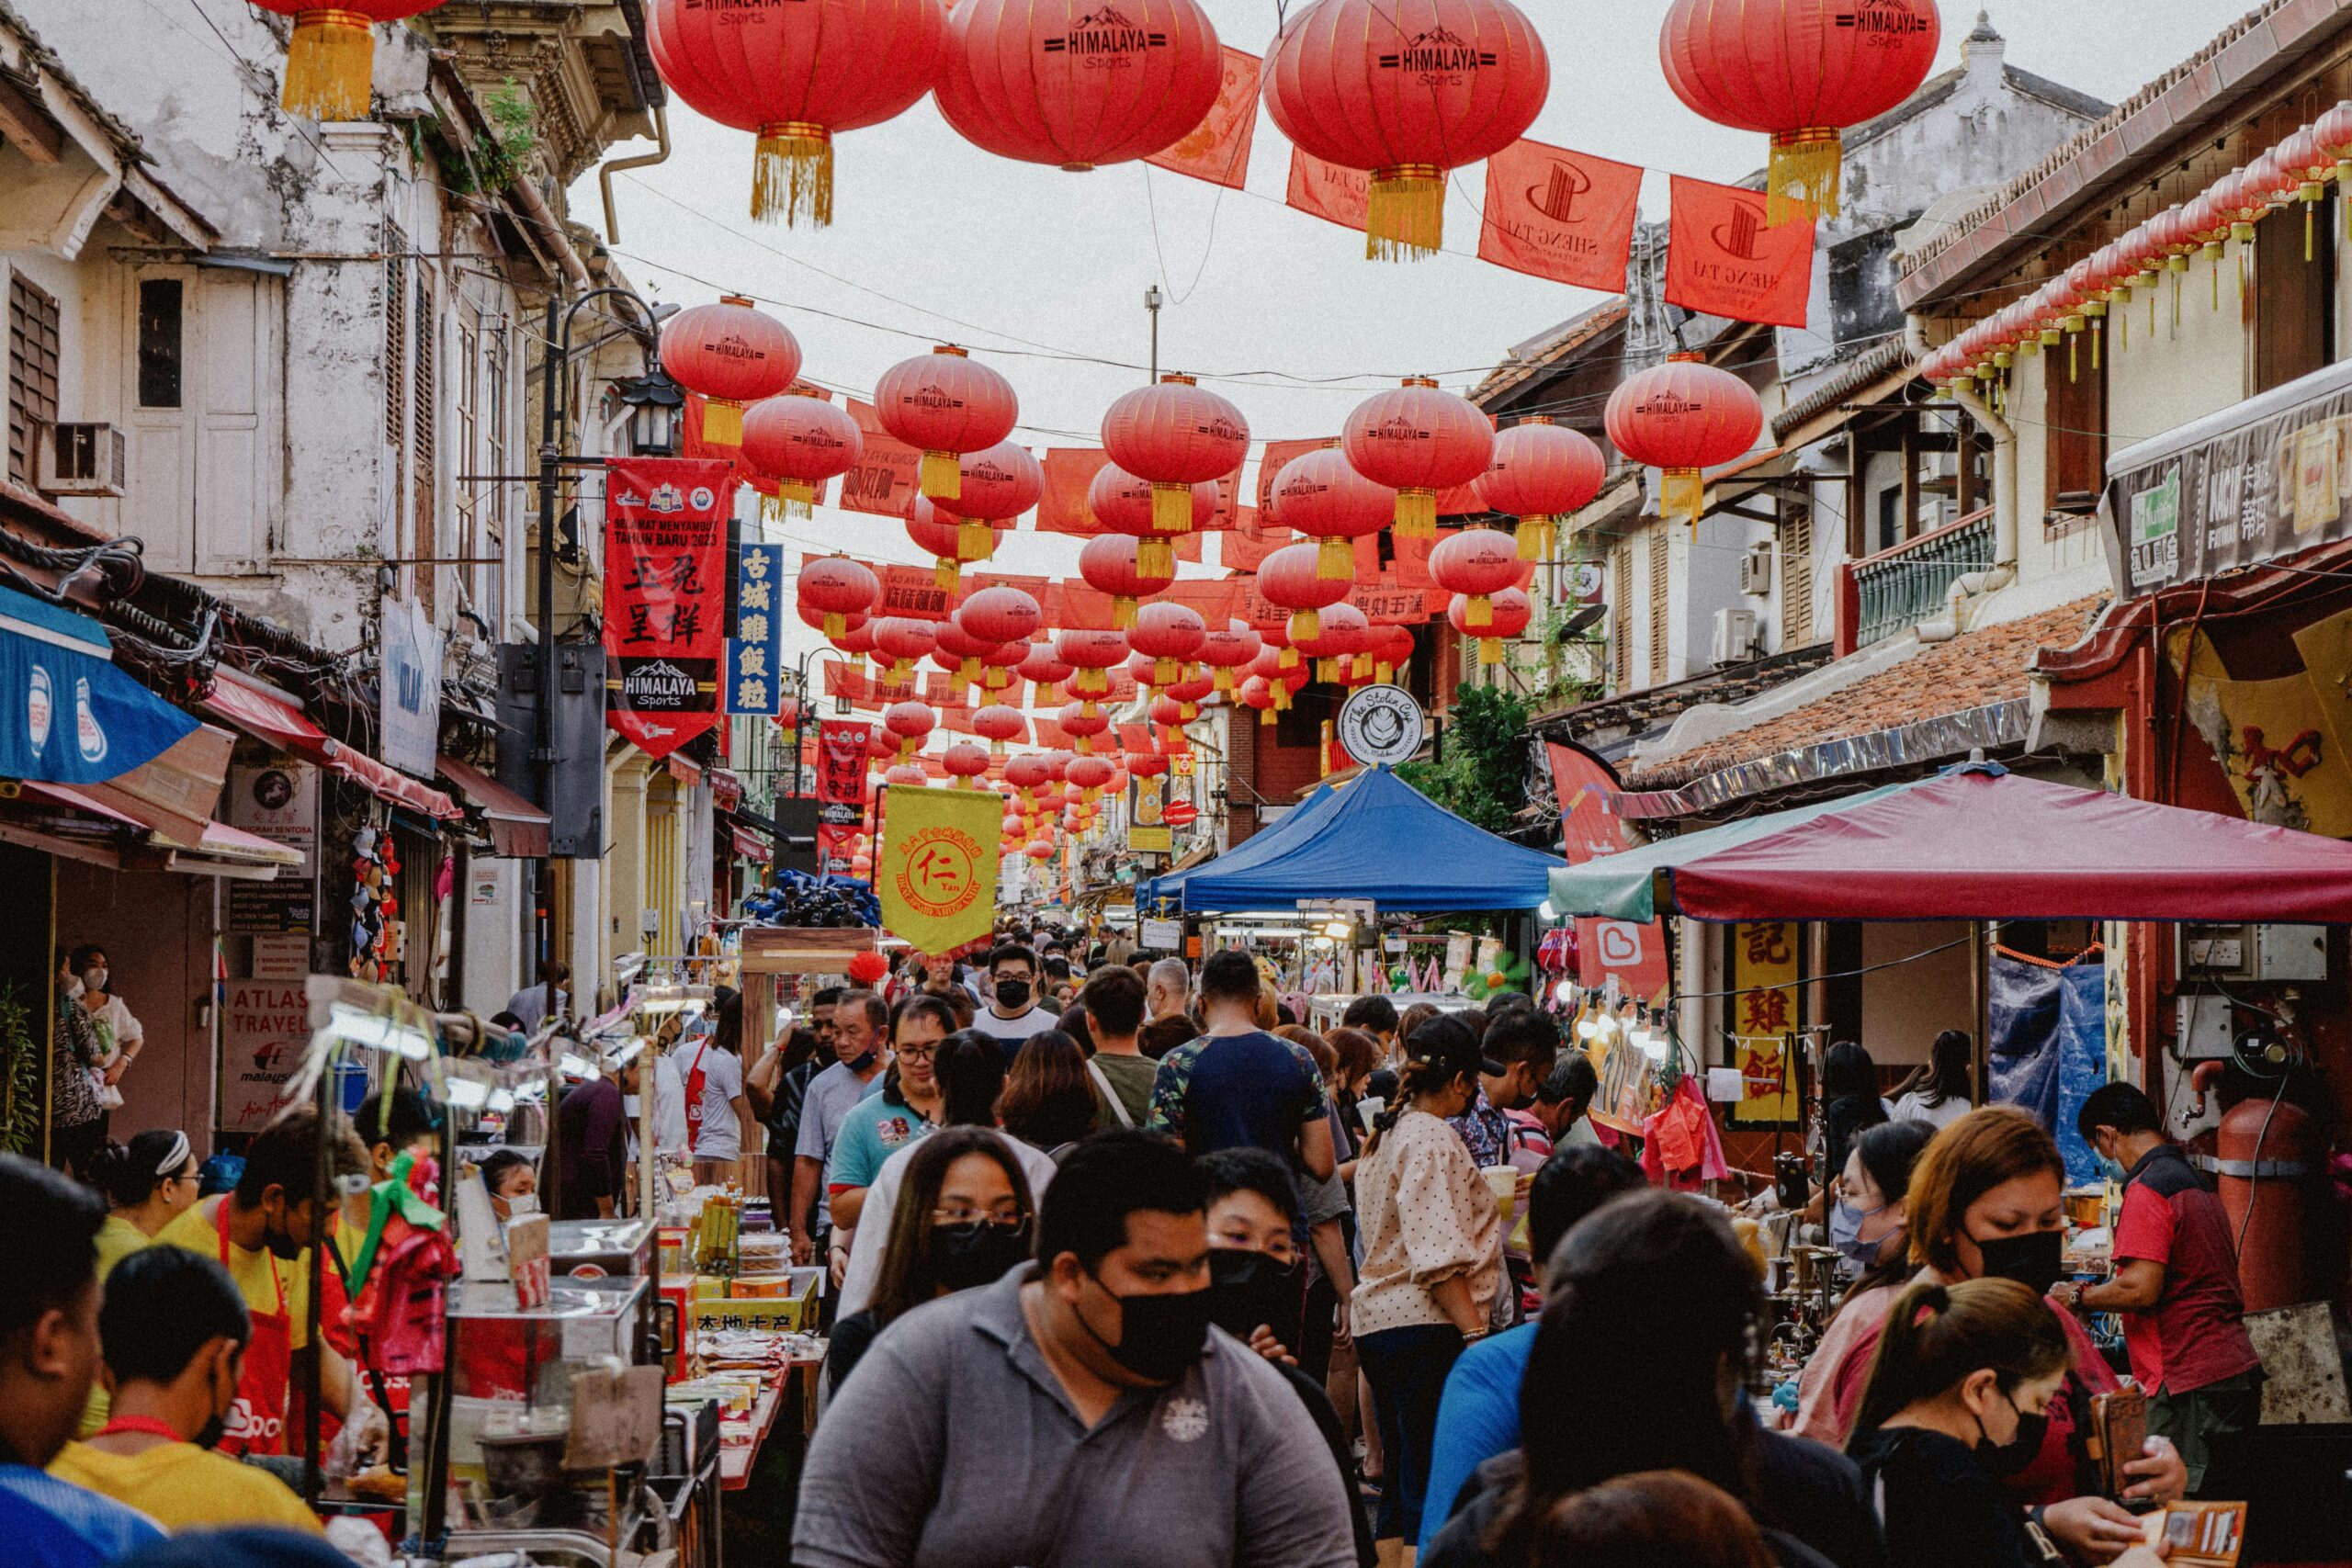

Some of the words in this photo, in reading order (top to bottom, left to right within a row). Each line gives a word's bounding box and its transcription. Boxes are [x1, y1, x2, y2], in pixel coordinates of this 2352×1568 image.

[1857, 10, 1916, 35] HIMALAYA
[1069, 29, 1147, 54] HIMALAYA
[1082, 56, 1132, 75] Sports
[1403, 48, 1478, 72] HIMALAYA
[1417, 73, 1463, 89] Sports
[716, 343, 754, 360] HIMALAYA
[914, 395, 952, 410] HIMALAYA
[1646, 402, 1689, 415] HIMALAYA
[1209, 425, 1239, 442] HIMALAYA
[1378, 428, 1417, 441] HIMALAYA
[801, 434, 836, 449] HIMALAYA
[970, 468, 1005, 482] HIMALAYA
[1131, 489, 1153, 500] HIMA
[1286, 482, 1317, 495] HIMALAYA
[614, 518, 656, 530] SELAMAT
[659, 520, 718, 532] MENYAMBUT
[615, 533, 653, 545] TAHUN
[656, 535, 688, 547] BARU
[691, 534, 718, 547] 2023
[626, 677, 695, 696] HIMALAYA
[638, 694, 682, 709] Sports
[1349, 705, 1367, 724] The
[1366, 691, 1398, 707] Stolen
[1398, 703, 1413, 724] Cup
[824, 808, 855, 820] HIMALAYA
[276, 826, 312, 834] SENTOSA
[917, 848, 957, 886] 仁
[941, 882, 961, 893] Yan
[234, 989, 308, 1009] ATLAS
[233, 1014, 309, 1033] TRAVEL
[241, 1071, 292, 1083] malaysi
